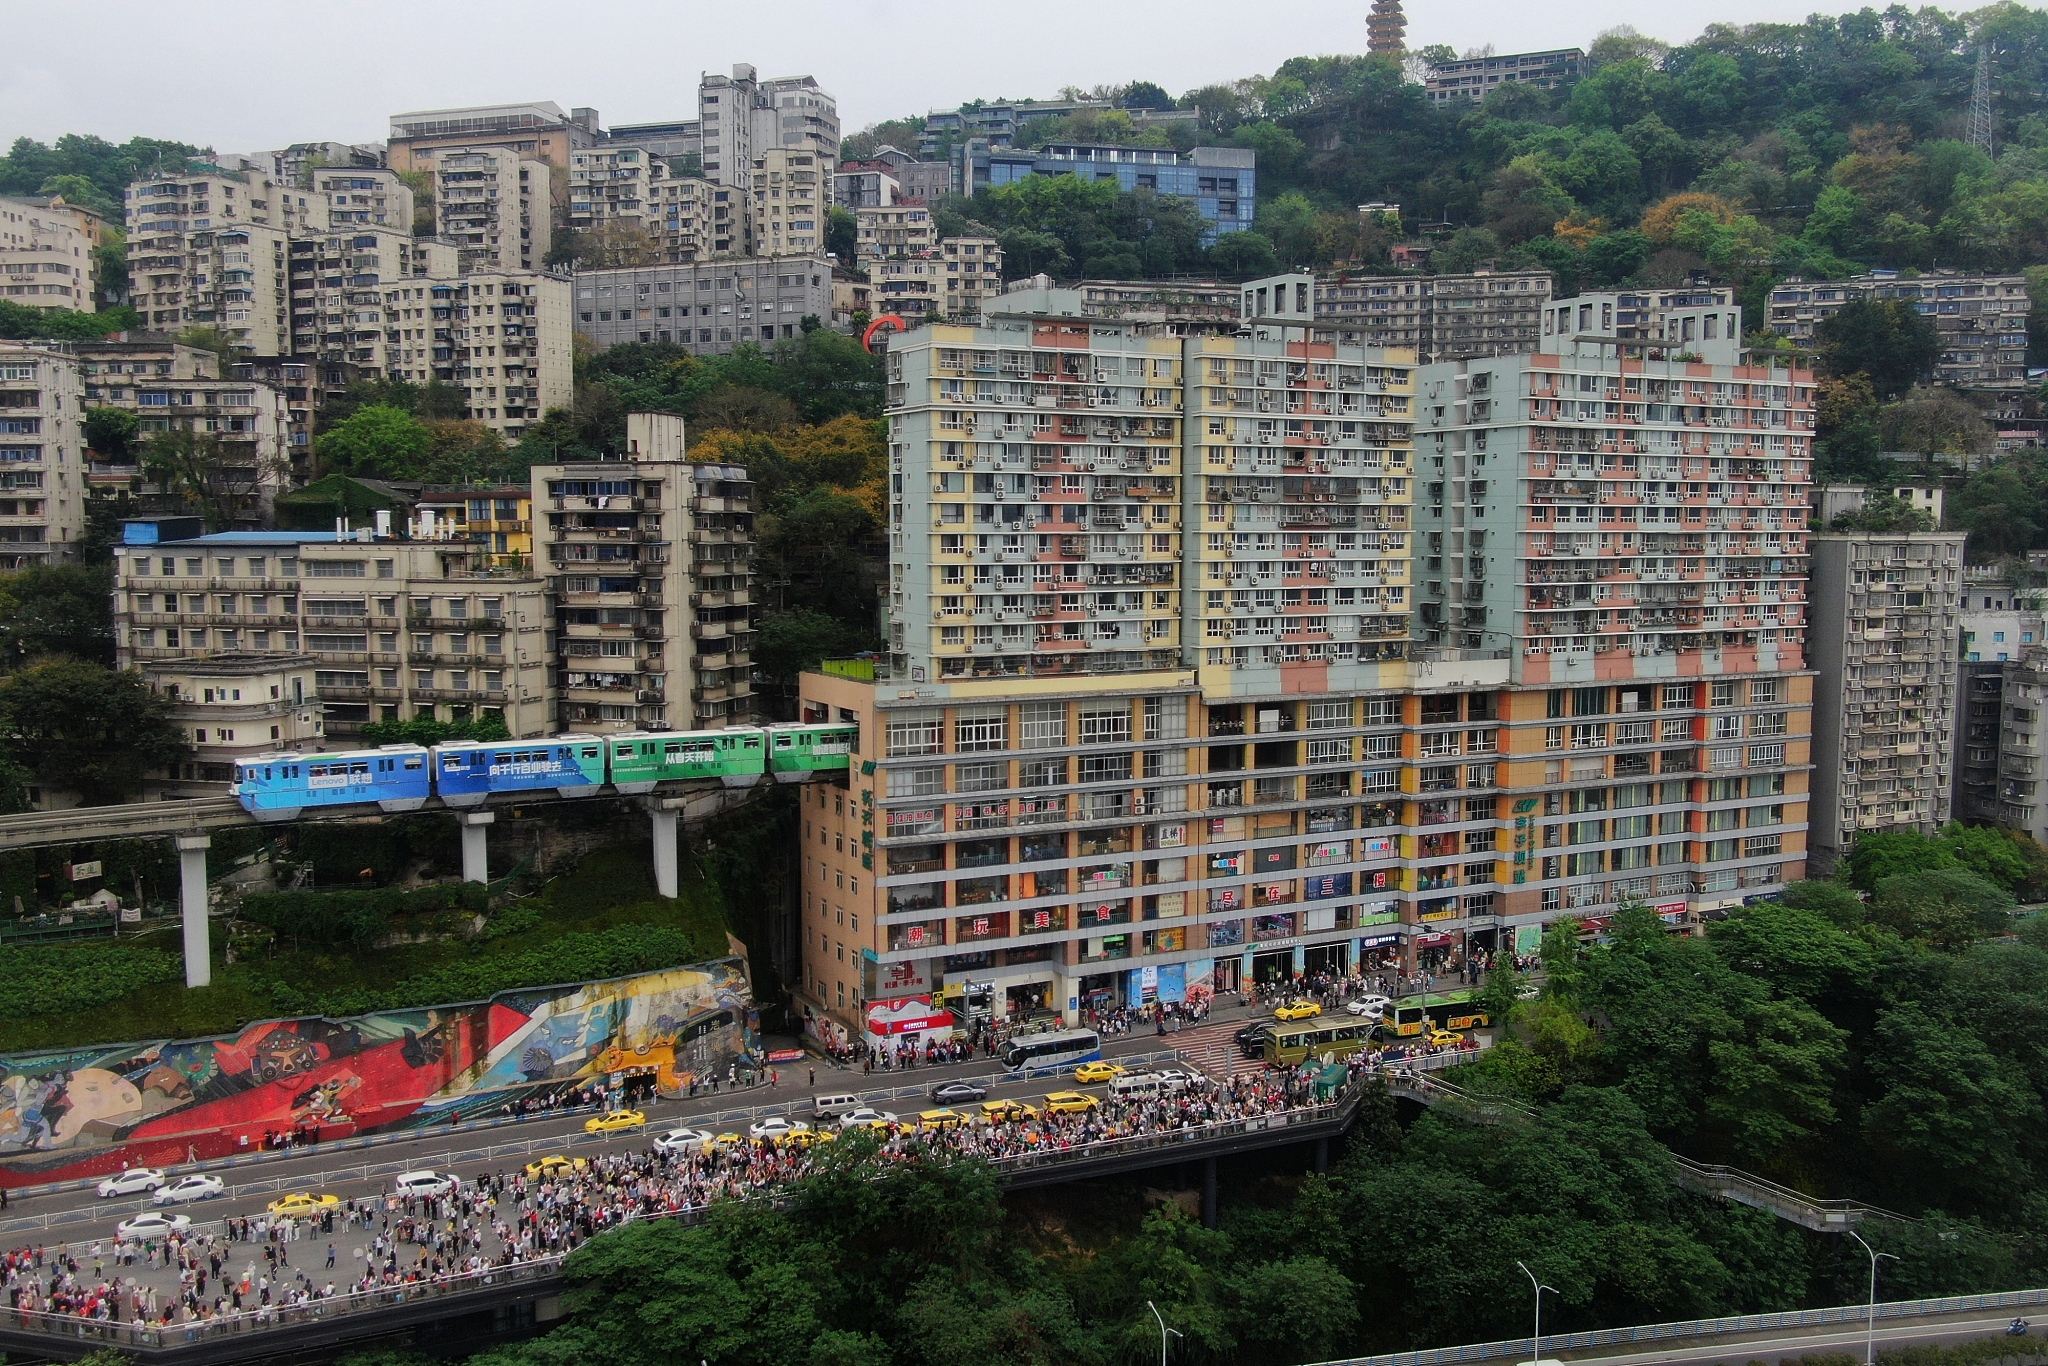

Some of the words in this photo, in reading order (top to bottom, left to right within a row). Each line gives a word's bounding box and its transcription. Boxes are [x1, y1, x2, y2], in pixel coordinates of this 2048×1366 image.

[665, 750, 714, 764] 从春天开始
[489, 761, 562, 776] 向千行百业驶去
[312, 777, 344, 786] Lenovo
